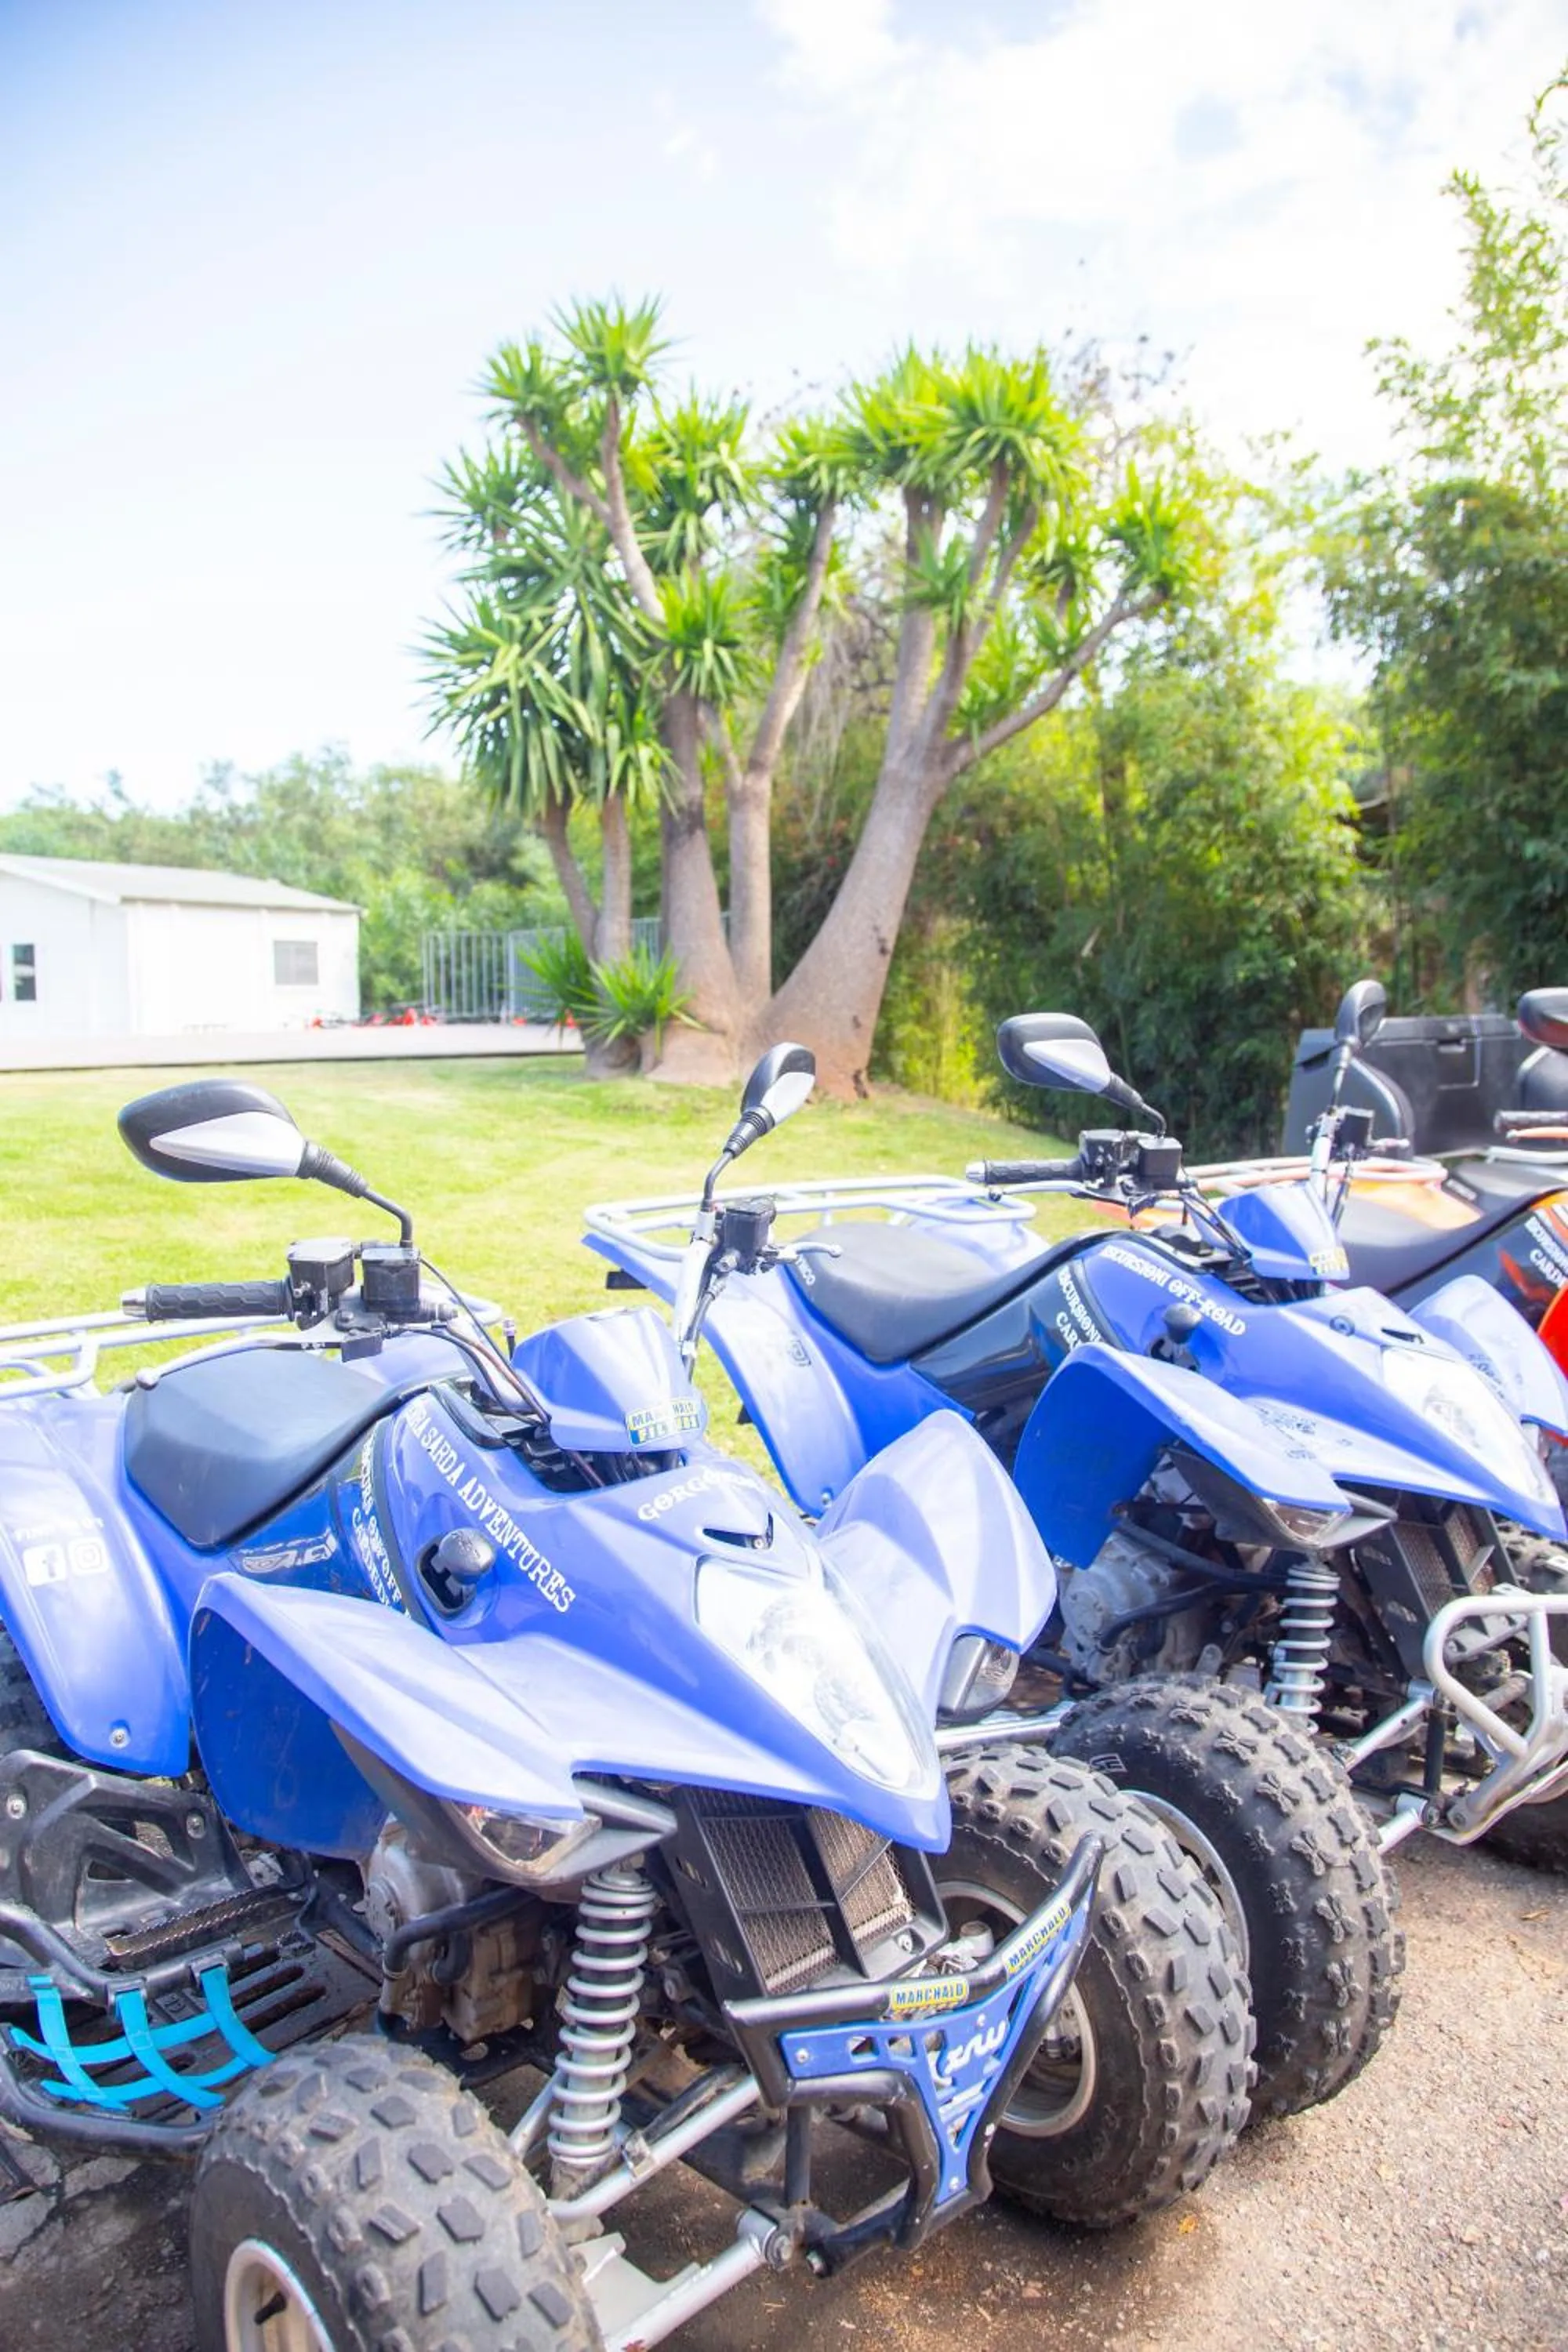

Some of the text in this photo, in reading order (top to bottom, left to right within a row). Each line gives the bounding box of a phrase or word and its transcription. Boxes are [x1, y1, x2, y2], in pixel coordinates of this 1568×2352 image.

[1167, 1279, 1247, 1336] OFF-ROAD
[420, 1426, 466, 1487] SARDA
[458, 1475, 577, 1613] ADVENTURES
